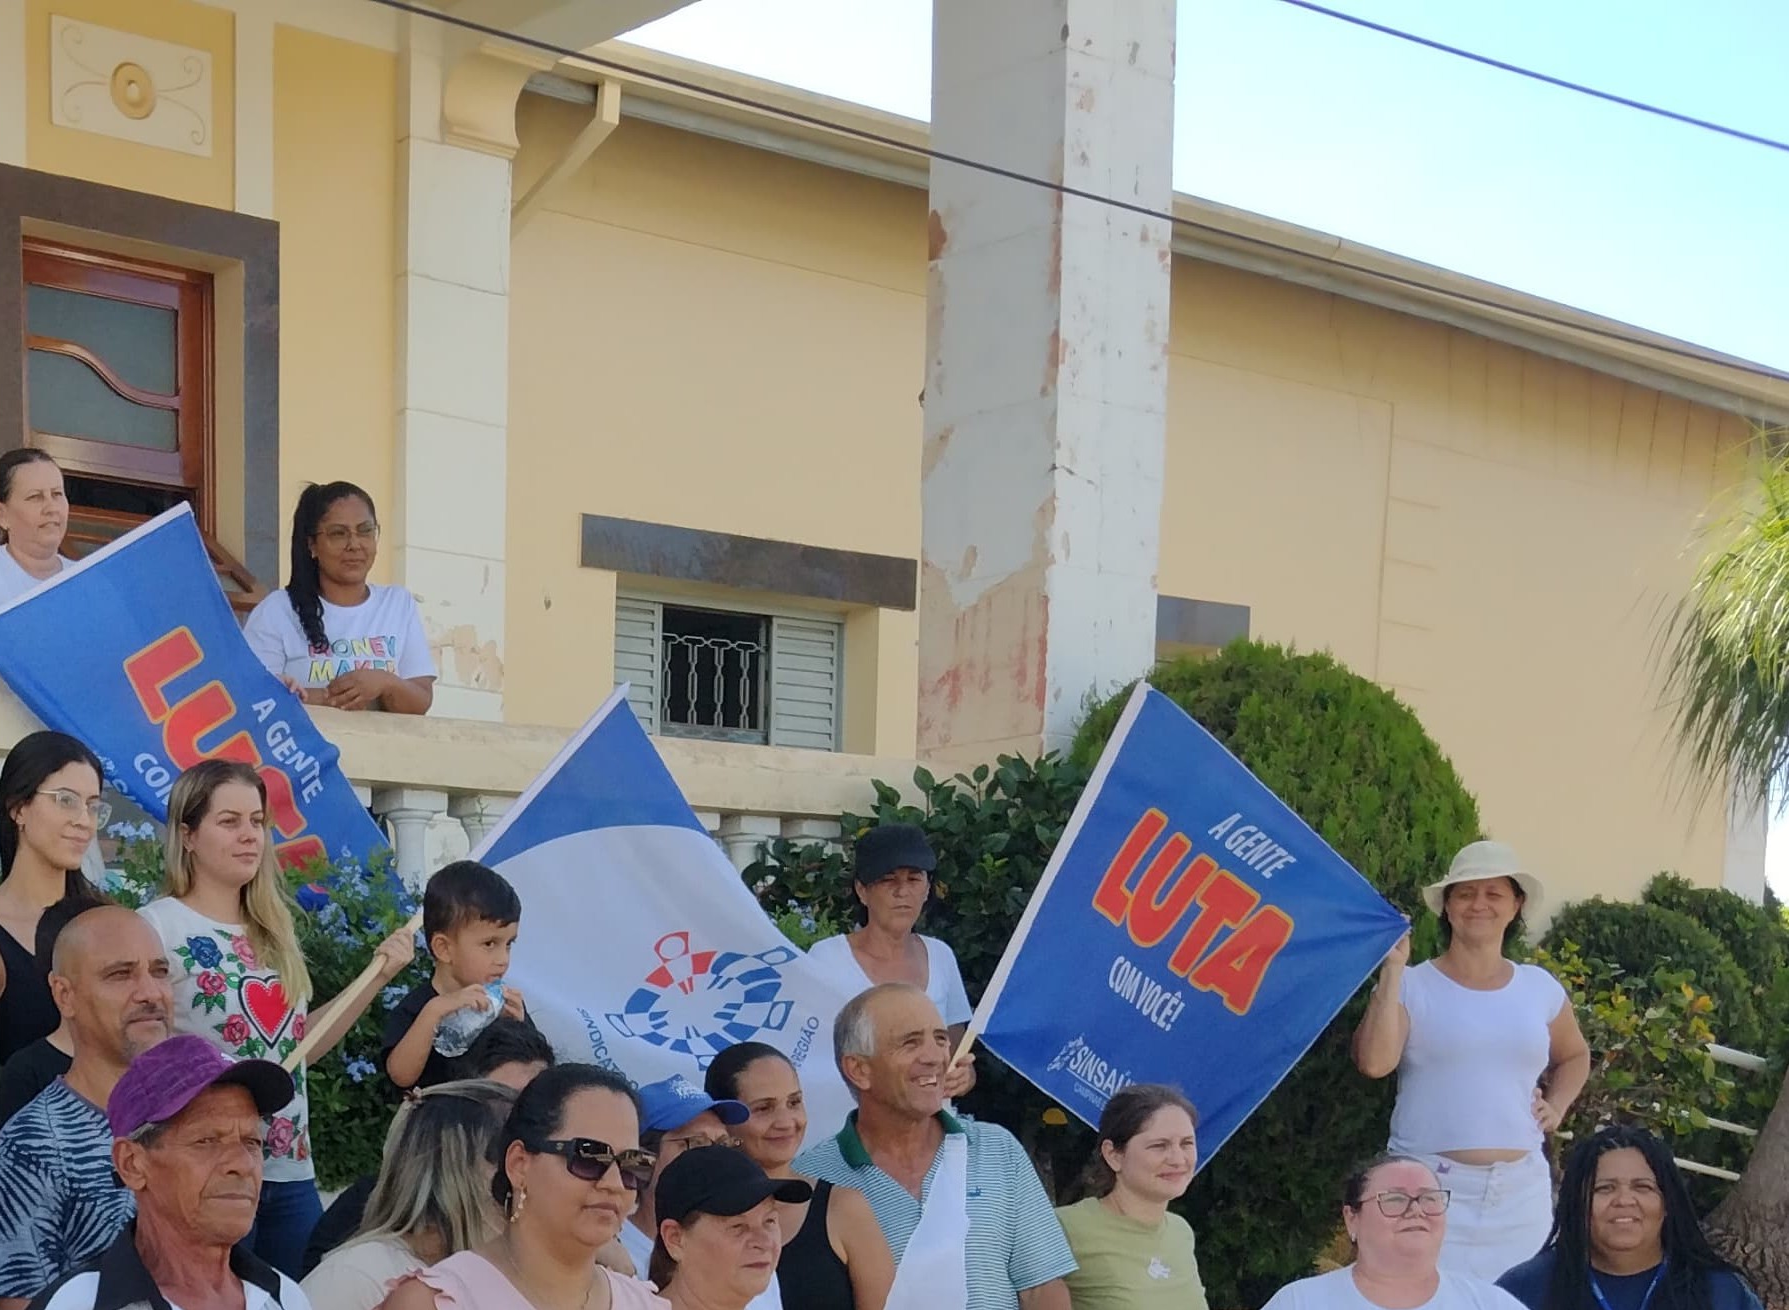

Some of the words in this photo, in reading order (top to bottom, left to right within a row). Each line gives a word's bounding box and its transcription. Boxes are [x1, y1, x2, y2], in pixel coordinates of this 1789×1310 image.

[252, 698, 277, 723] A
[266, 720, 324, 804] GENTE
[1207, 812, 1243, 840] A
[1224, 824, 1297, 879] GENTE
[1092, 807, 1295, 1016] LUTA
[1108, 955, 1143, 1003] COM
[1136, 976, 1185, 1031] VOCÊ!
